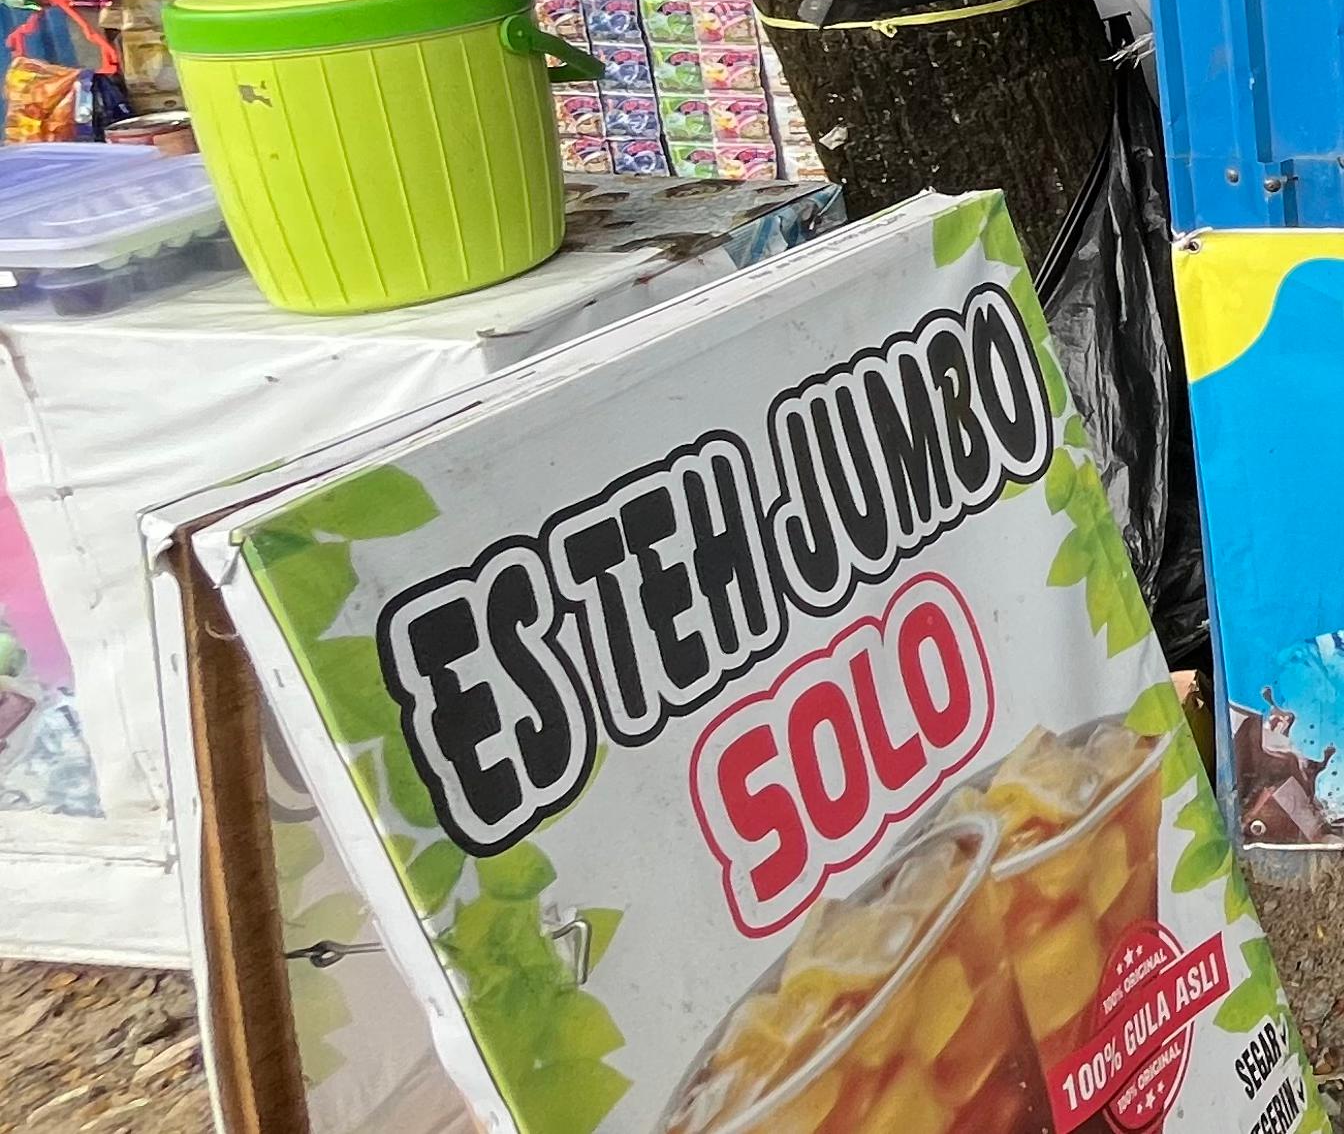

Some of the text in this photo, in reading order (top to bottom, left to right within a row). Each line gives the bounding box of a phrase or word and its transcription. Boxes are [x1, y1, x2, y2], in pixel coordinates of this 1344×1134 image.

[393, 290, 1047, 842] ES TEH JUMBO
[704, 588, 976, 919] SOLO
[1123, 947, 1169, 994] ORIGINAL
[1062, 952, 1221, 1111] 100% GULA ASLI
[1136, 1040, 1182, 1088] ORIGINAL
[1234, 1022, 1282, 1101] SEGAR
